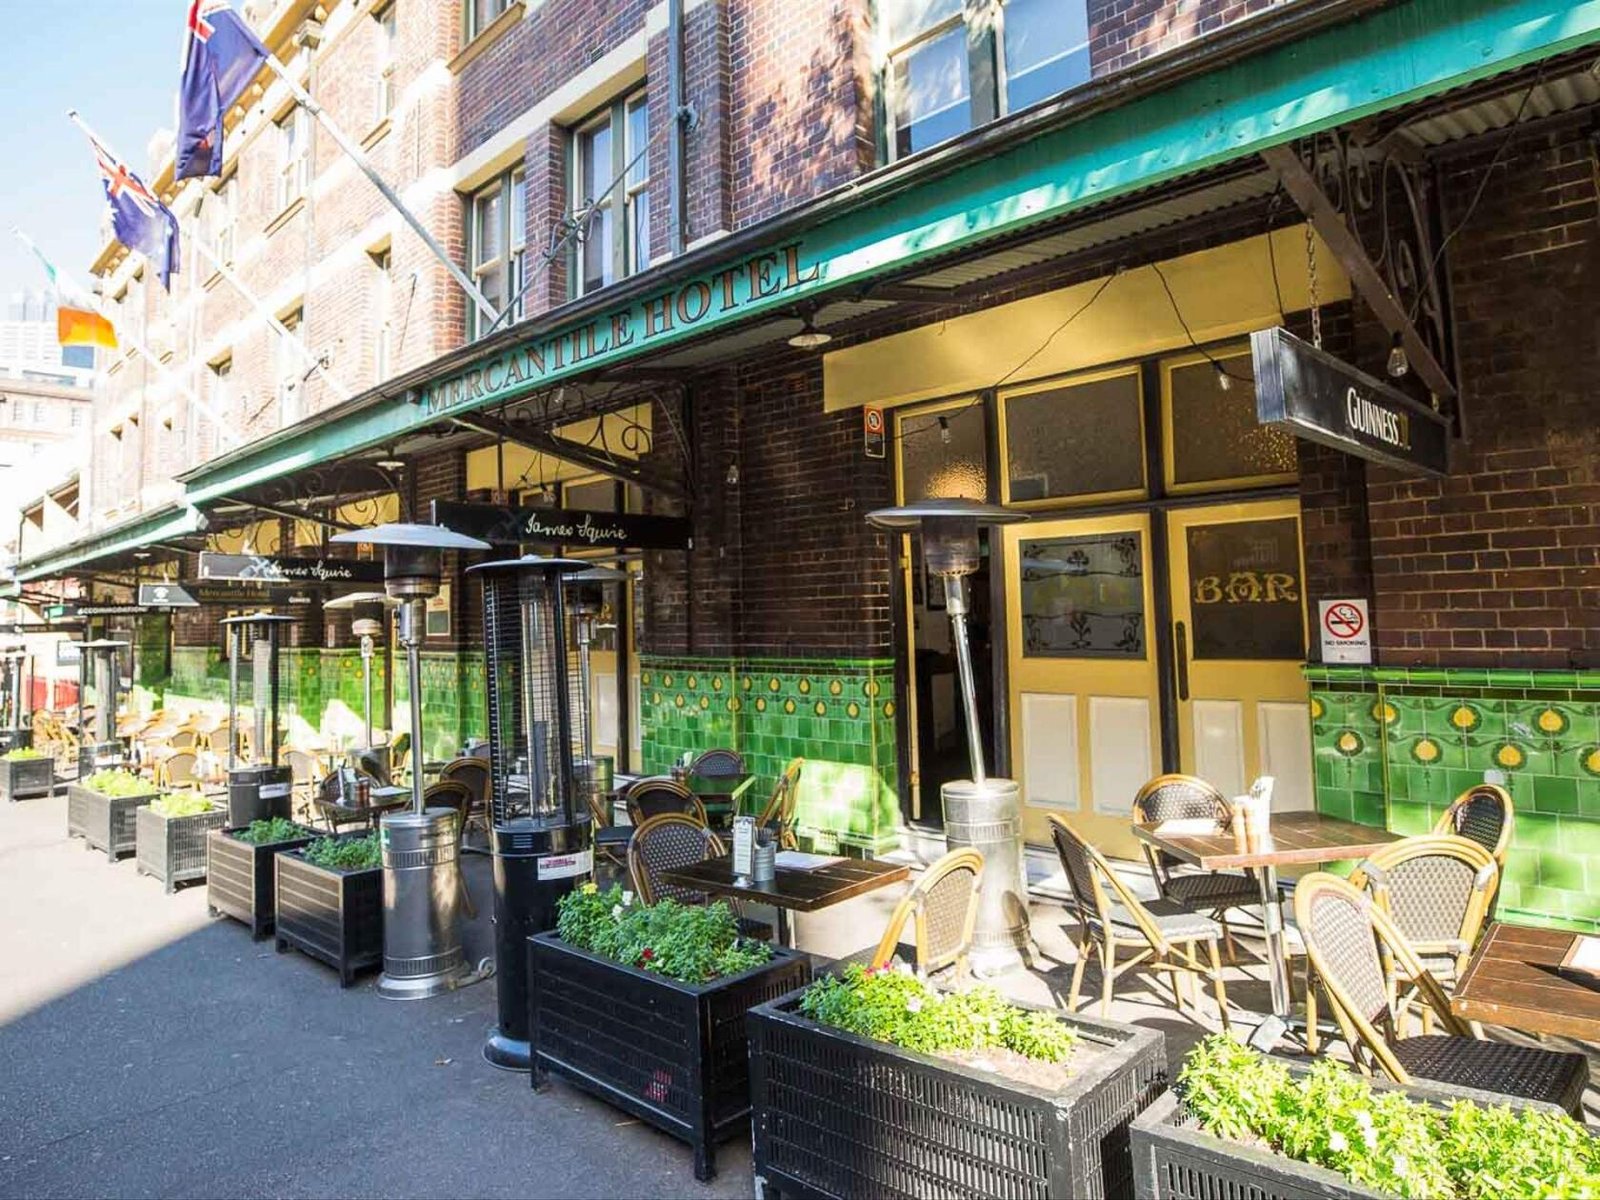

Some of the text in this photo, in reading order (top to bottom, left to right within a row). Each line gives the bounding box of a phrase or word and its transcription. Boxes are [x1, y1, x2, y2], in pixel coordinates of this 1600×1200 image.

[426, 241, 821, 417] MERCANTILE HOTEL
[1346, 386, 1399, 446] GUINNESS
[525, 513, 628, 544] James Squire
[1194, 571, 1299, 604] BAR
